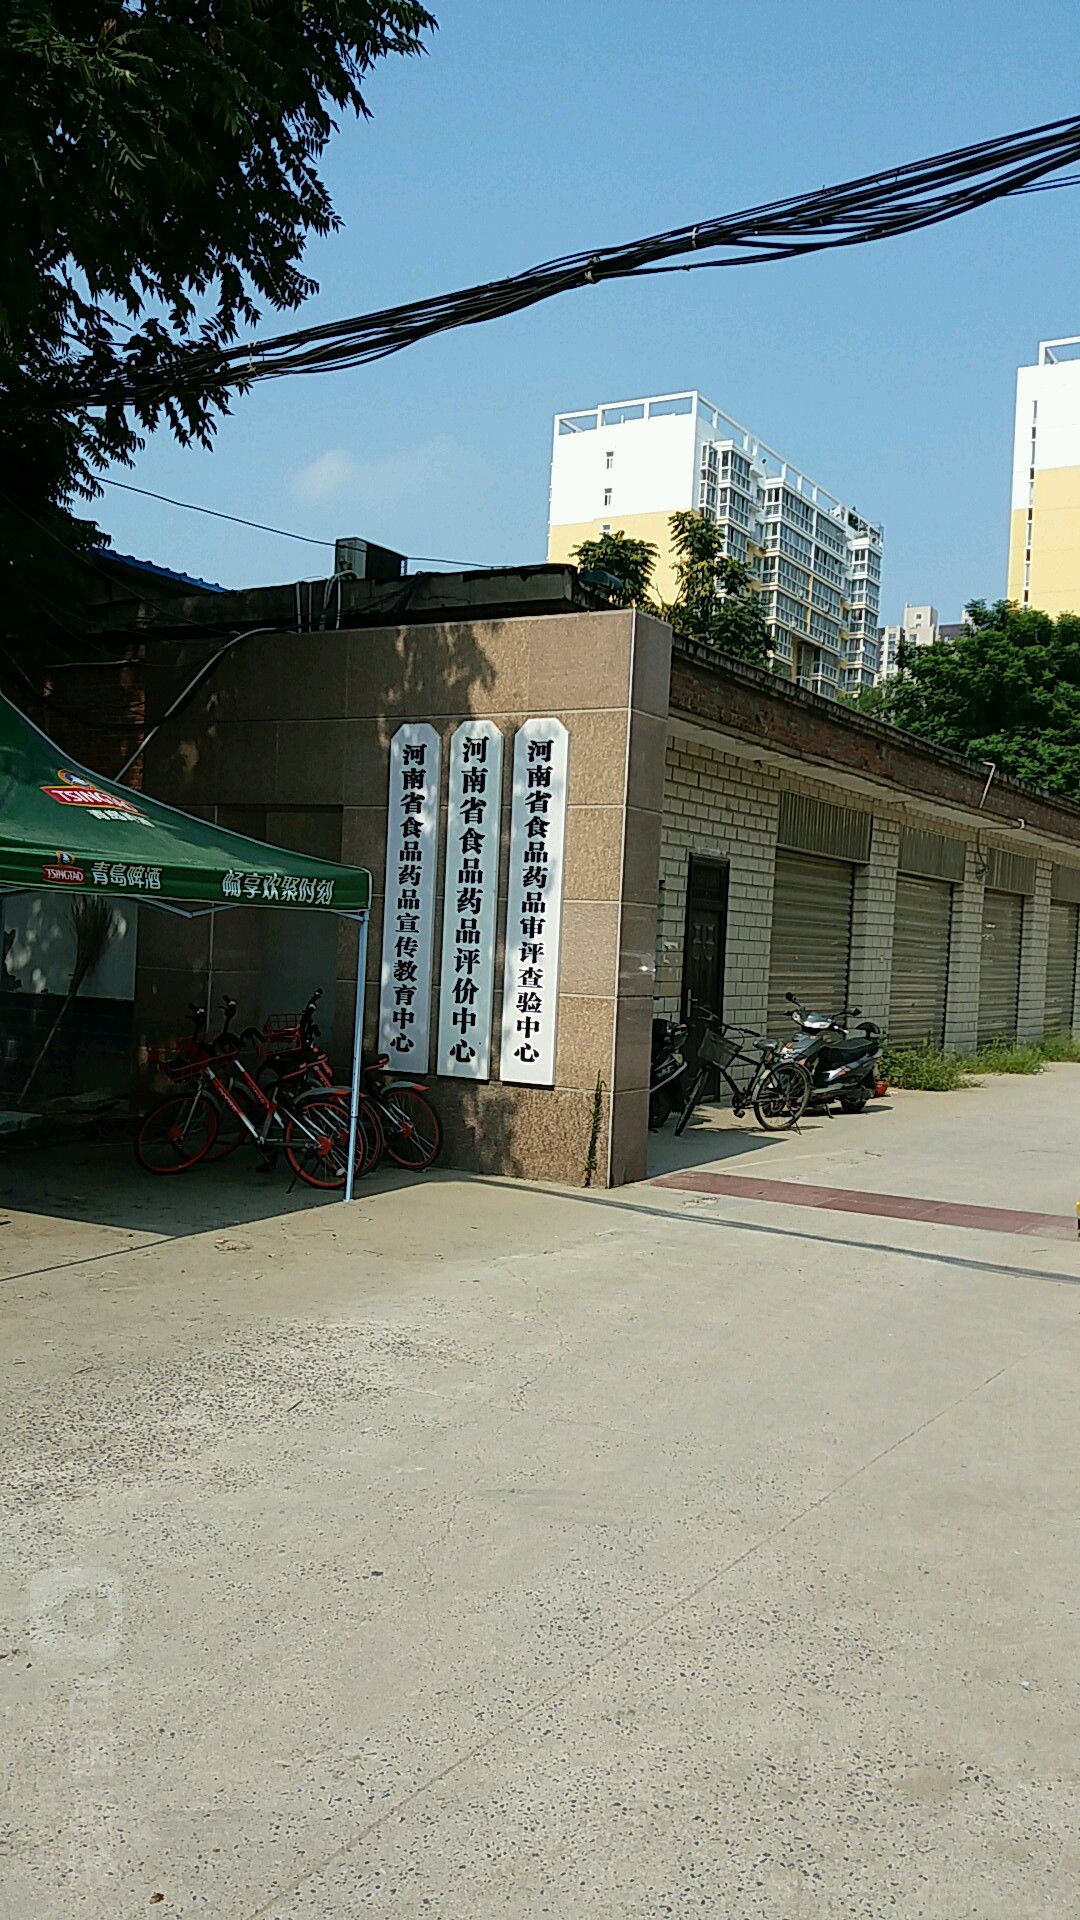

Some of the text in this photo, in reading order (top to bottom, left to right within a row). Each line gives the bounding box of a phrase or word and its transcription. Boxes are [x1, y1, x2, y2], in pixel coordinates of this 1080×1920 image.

[46, 867, 84, 882] TSINGTAO
[222, 869, 335, 905] 畅享欢聚时刻
[389, 744, 427, 1053] 河南省食品药品宣传教育中心
[449, 736, 490, 1063] 河南省食品药品评价中心
[514, 739, 554, 1063] 河南省食品药品审评查验中心
